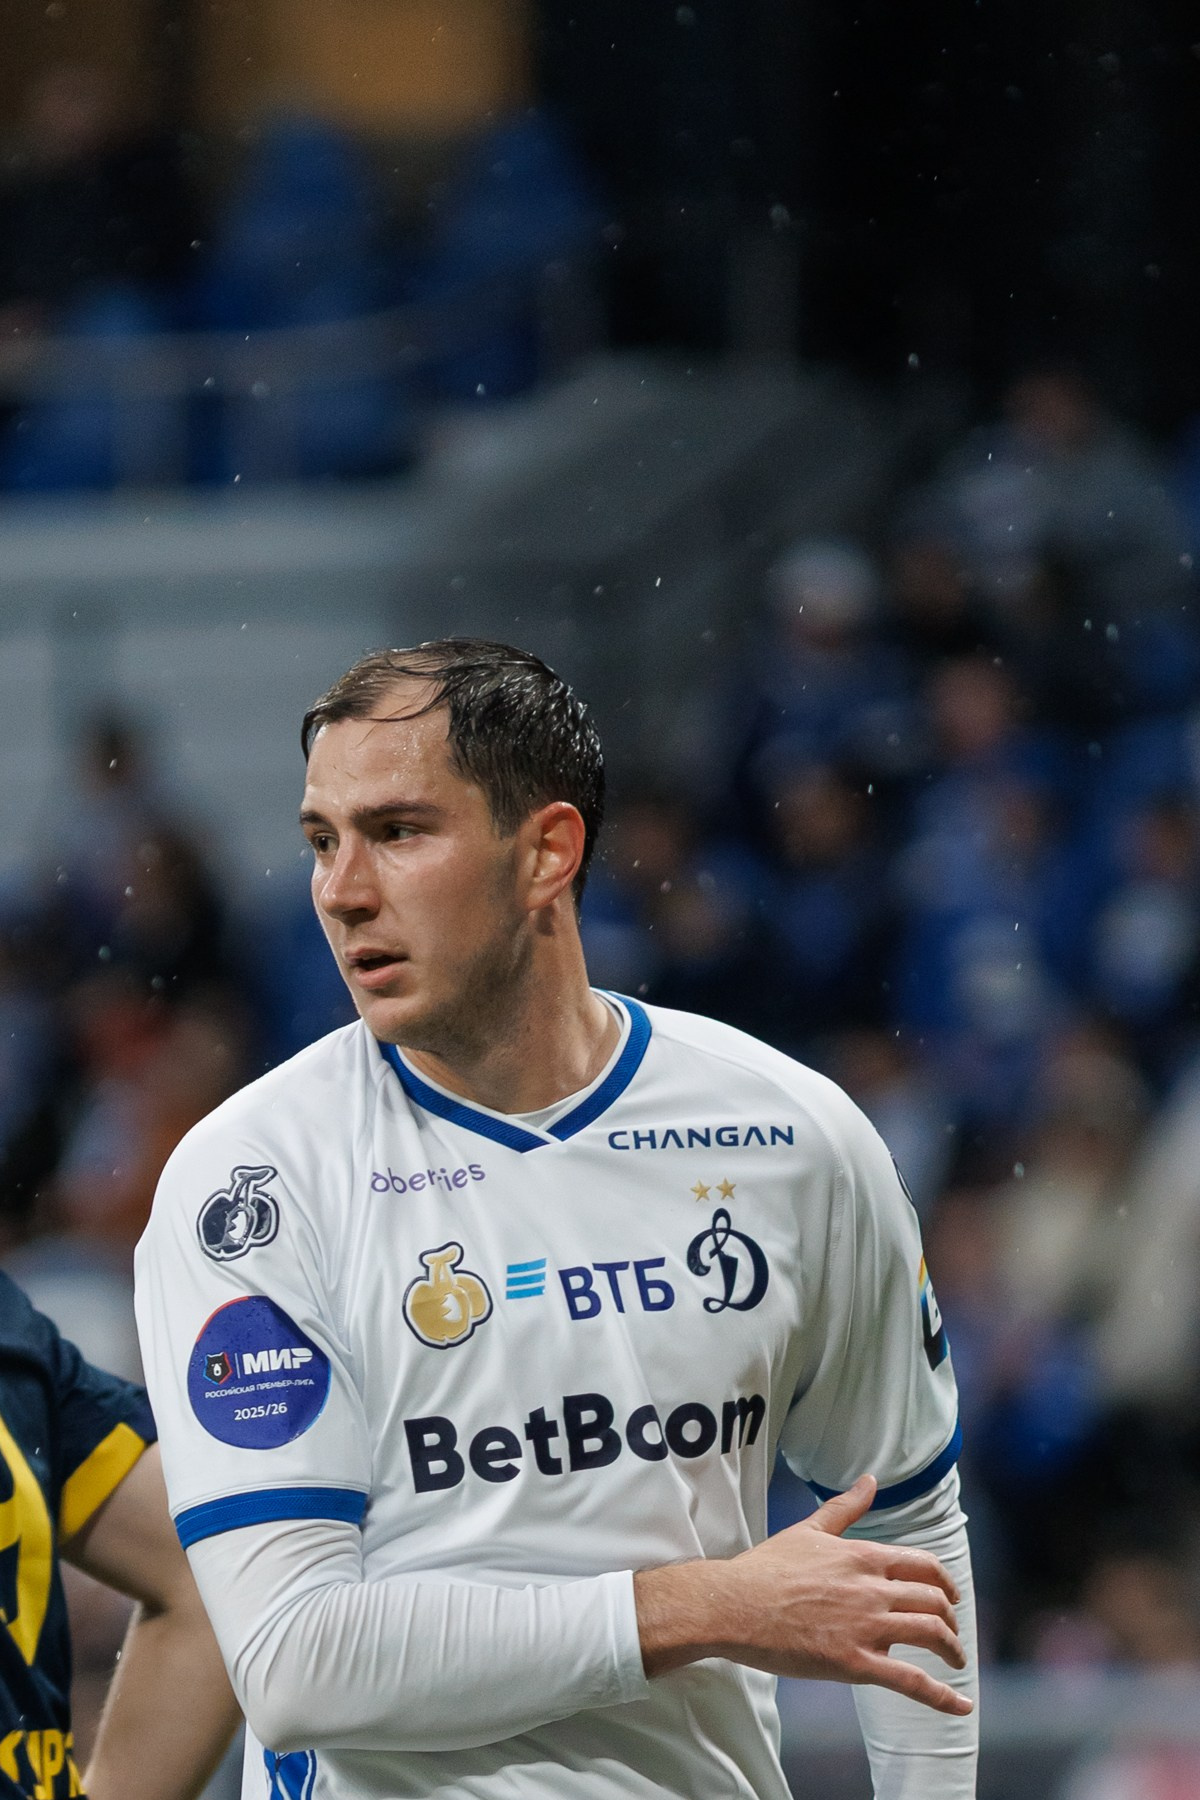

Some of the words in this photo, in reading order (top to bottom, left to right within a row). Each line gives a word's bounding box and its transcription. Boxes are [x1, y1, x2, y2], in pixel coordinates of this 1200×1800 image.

[607, 1125, 795, 1152] CHANGAN
[558, 1257, 676, 1322] ВТБ
[242, 1347, 313, 1375] МИР
[204, 1384, 256, 1399] РОССИЙСКАЯ
[256, 1378, 315, 1391] ПРЕМЬЕР-ЛИГА
[233, 1402, 288, 1421] 2025/26
[404, 1392, 766, 1494] BetBoom
